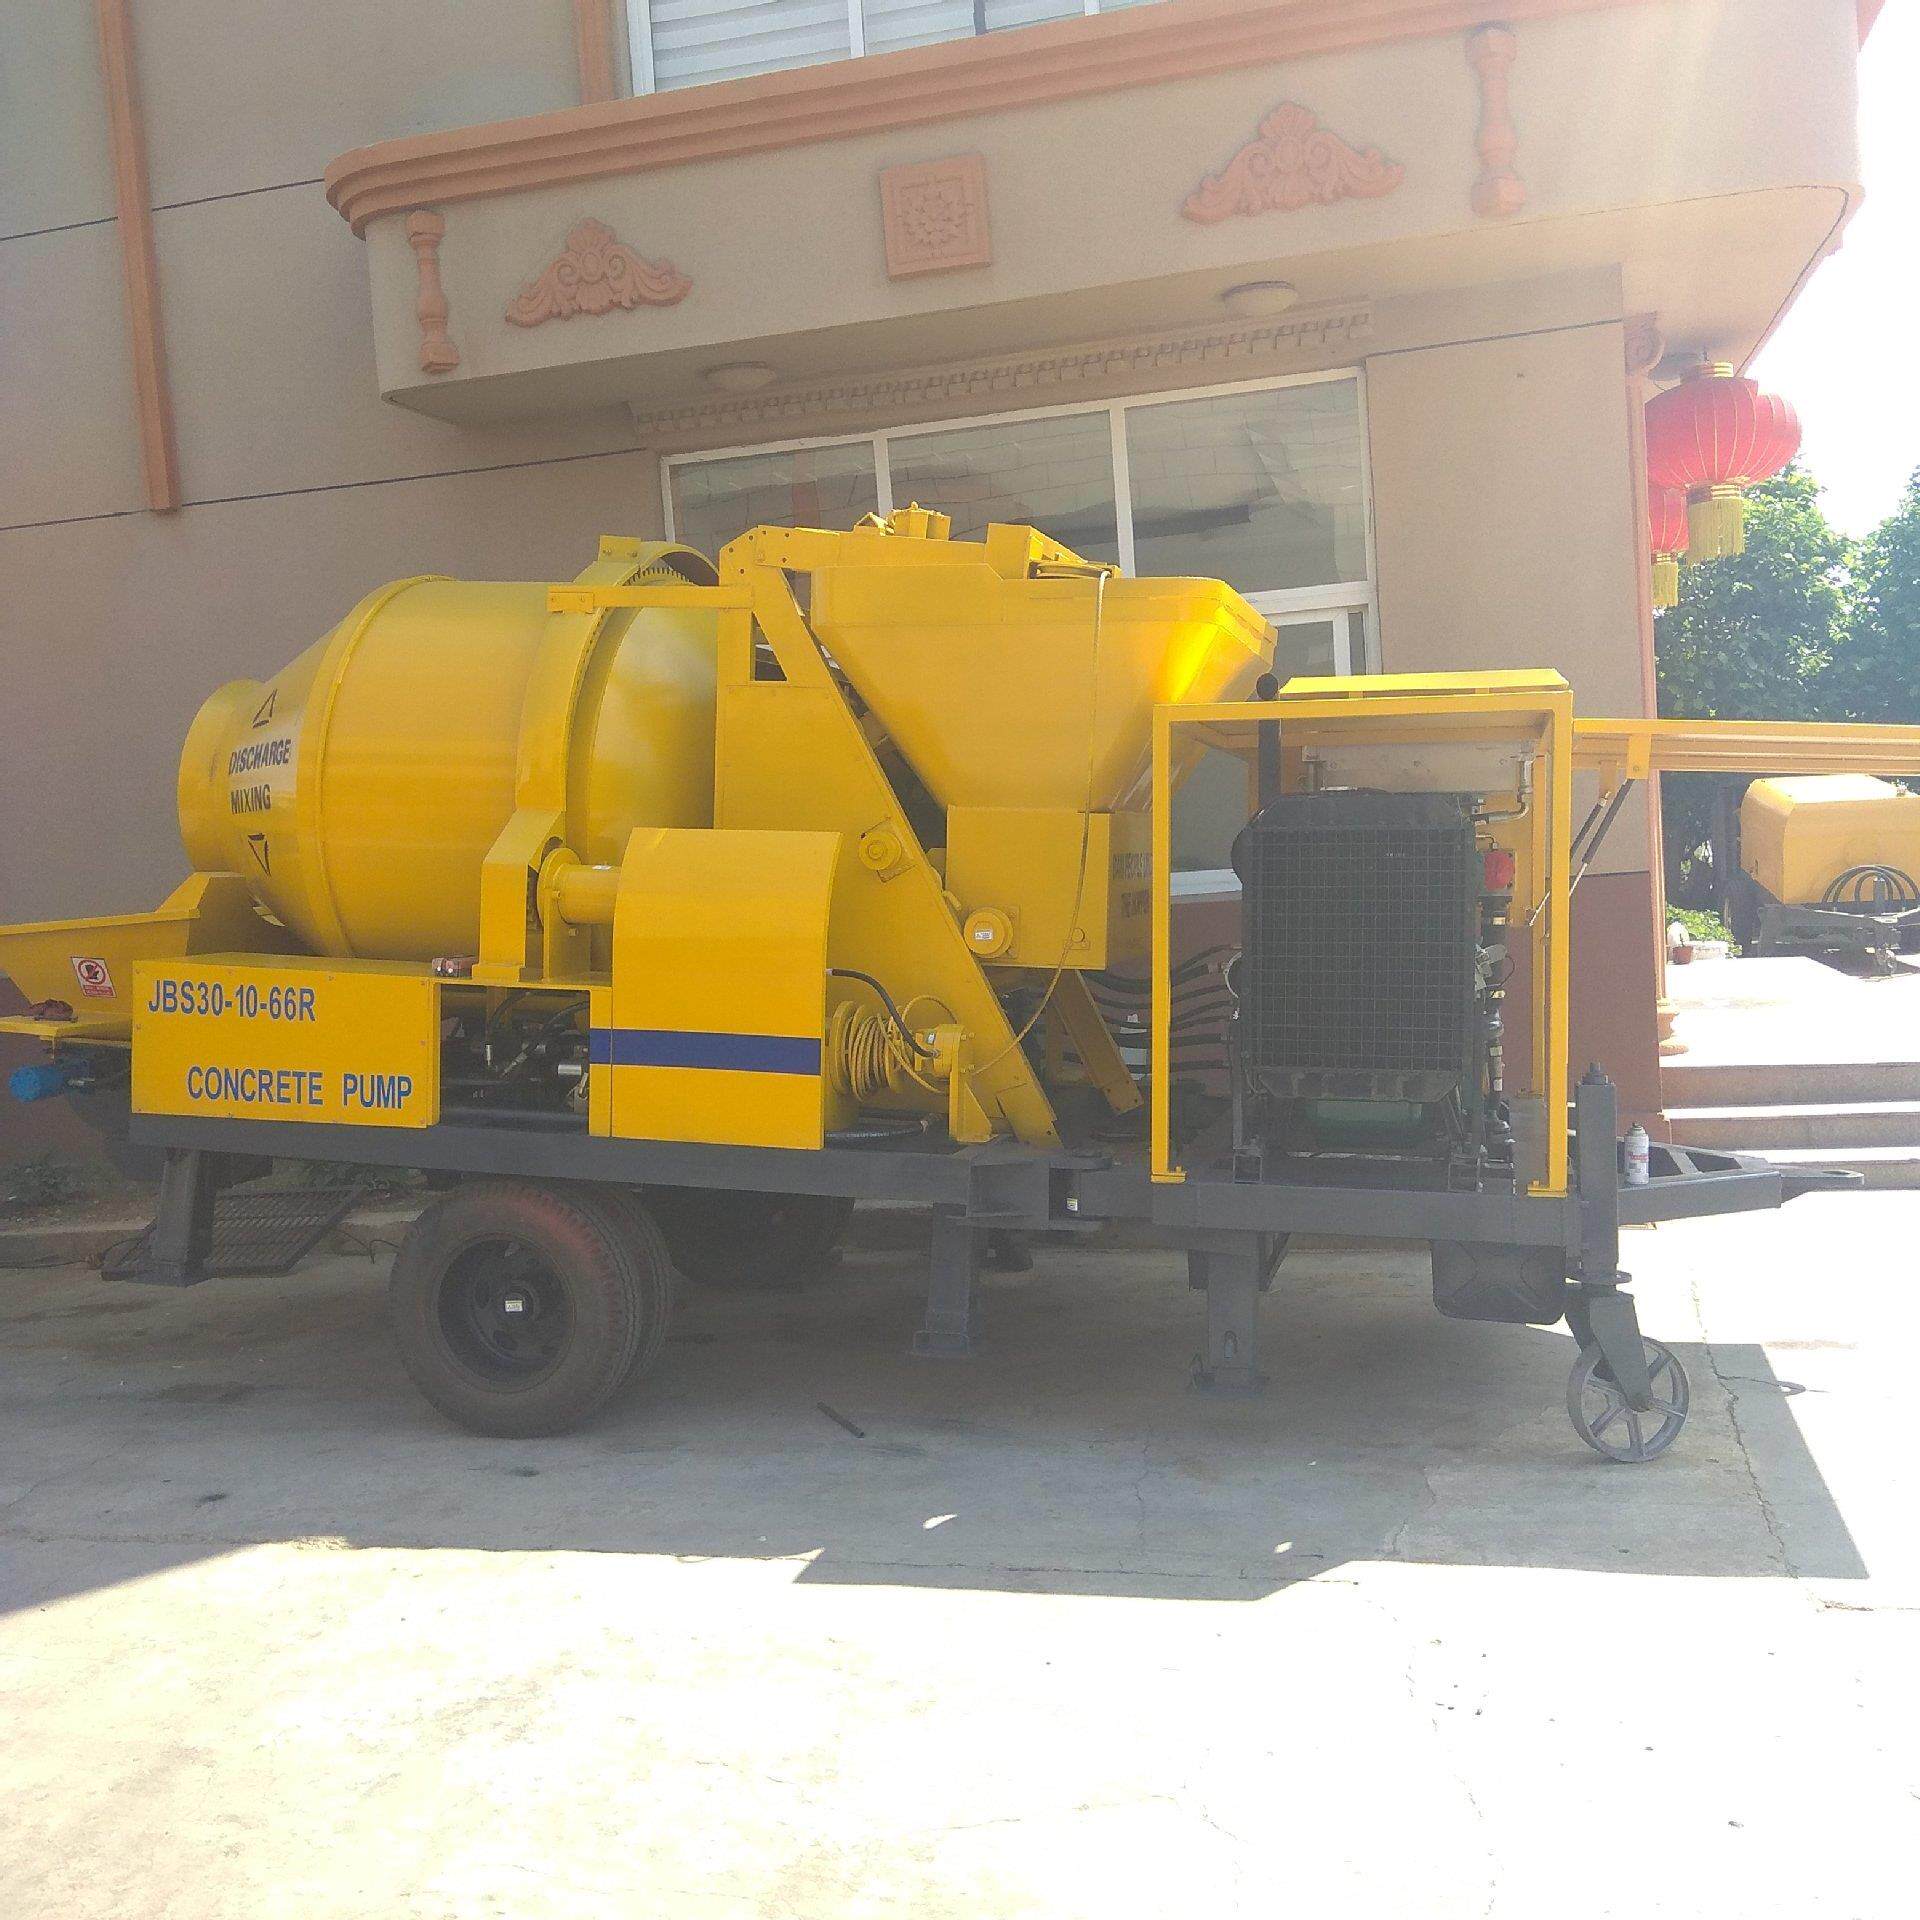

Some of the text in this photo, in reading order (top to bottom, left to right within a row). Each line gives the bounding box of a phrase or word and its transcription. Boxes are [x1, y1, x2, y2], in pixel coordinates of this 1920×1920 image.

[229, 738, 292, 775] DISCHARGE
[230, 783, 271, 814] MIXING
[149, 979, 316, 1021] JBS30-10-66R
[187, 1066, 412, 1109] CONCRETE PUMP
